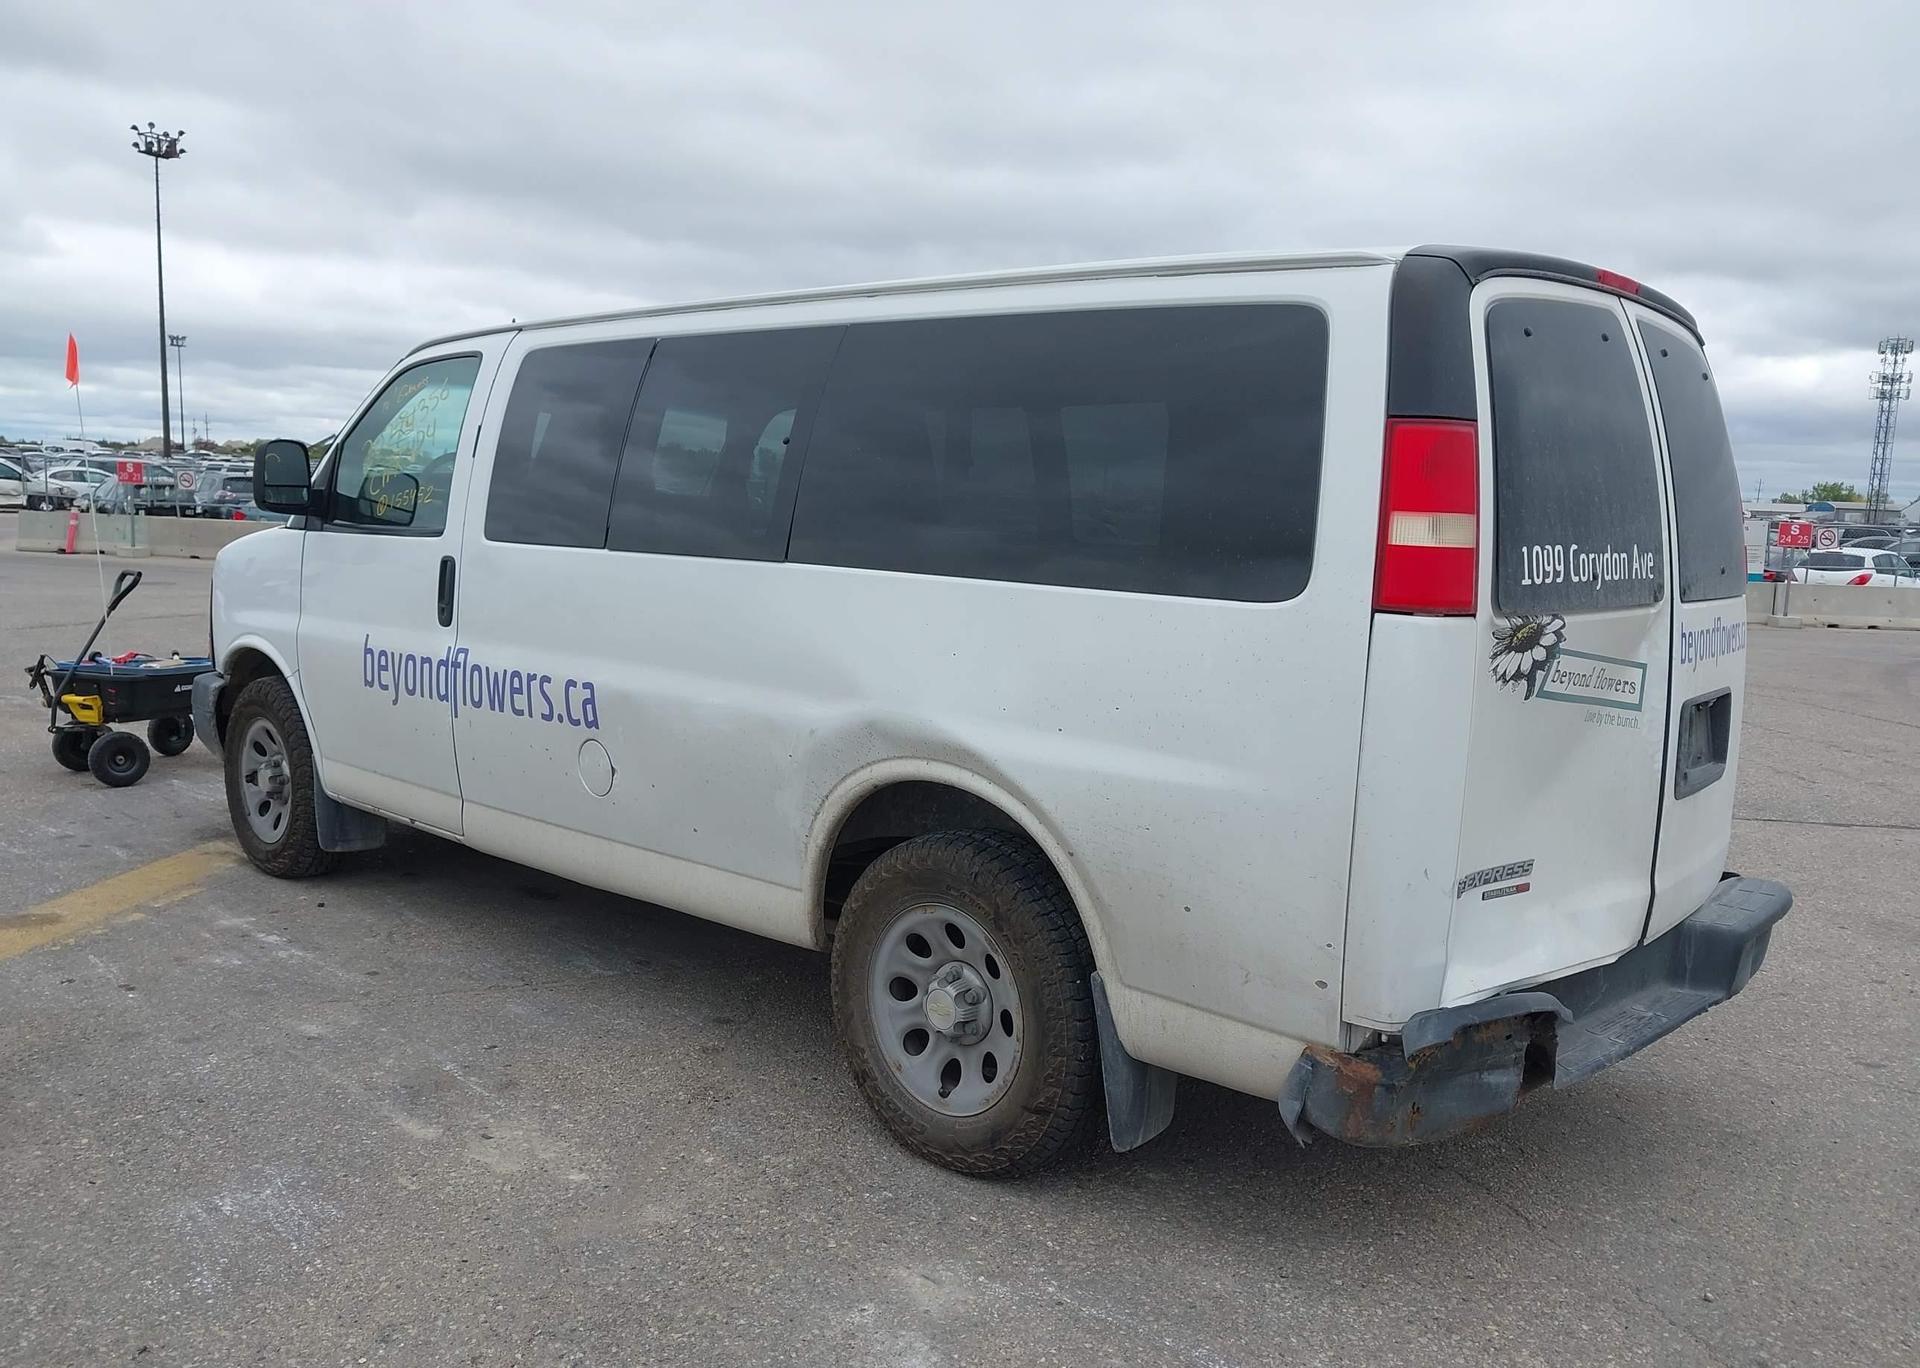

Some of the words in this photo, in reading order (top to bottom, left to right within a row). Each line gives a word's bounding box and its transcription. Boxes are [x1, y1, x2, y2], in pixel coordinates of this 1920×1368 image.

[126, 462, 134, 473] S
[1779, 535, 1792, 544] 24
[1797, 535, 1809, 544] 25
[1790, 524, 1800, 535] S
[1521, 544, 1564, 585] 1099
[1569, 543, 1628, 590] Corydon
[1632, 543, 1654, 579] Ave
[363, 634, 600, 730] beyondflowers.ca
[1551, 660, 1597, 692] beyond
[1593, 666, 1637, 695] flowers
[1604, 711, 1616, 726] the
[1462, 860, 1534, 892] EXPRESS
